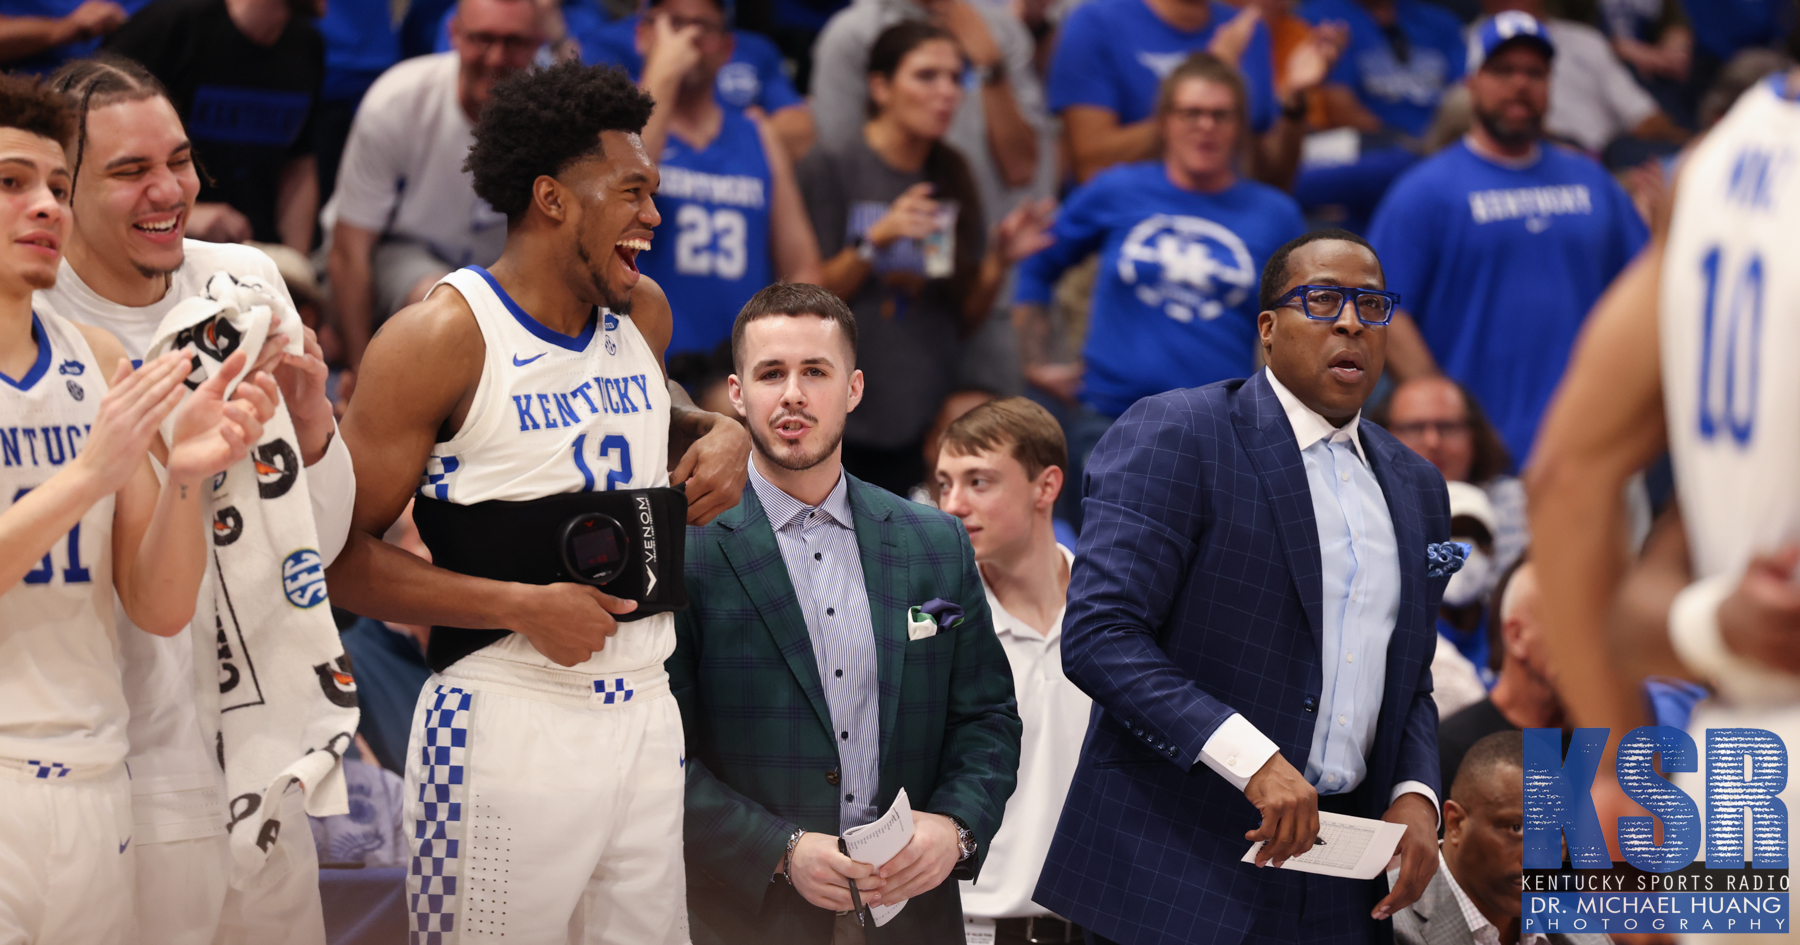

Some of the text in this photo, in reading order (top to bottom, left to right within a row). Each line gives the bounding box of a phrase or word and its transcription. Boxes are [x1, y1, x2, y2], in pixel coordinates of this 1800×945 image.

[658, 165, 765, 210] ENTUCKY
[1468, 184, 1591, 224] KENTUCKY
[676, 204, 748, 280] 23
[1699, 246, 1763, 446] 10
[511, 374, 652, 431] KENTUCKY
[0, 423, 92, 467] NTUC
[571, 433, 633, 492] 12
[635, 497, 655, 563] VENOM
[284, 552, 328, 607] SEC
